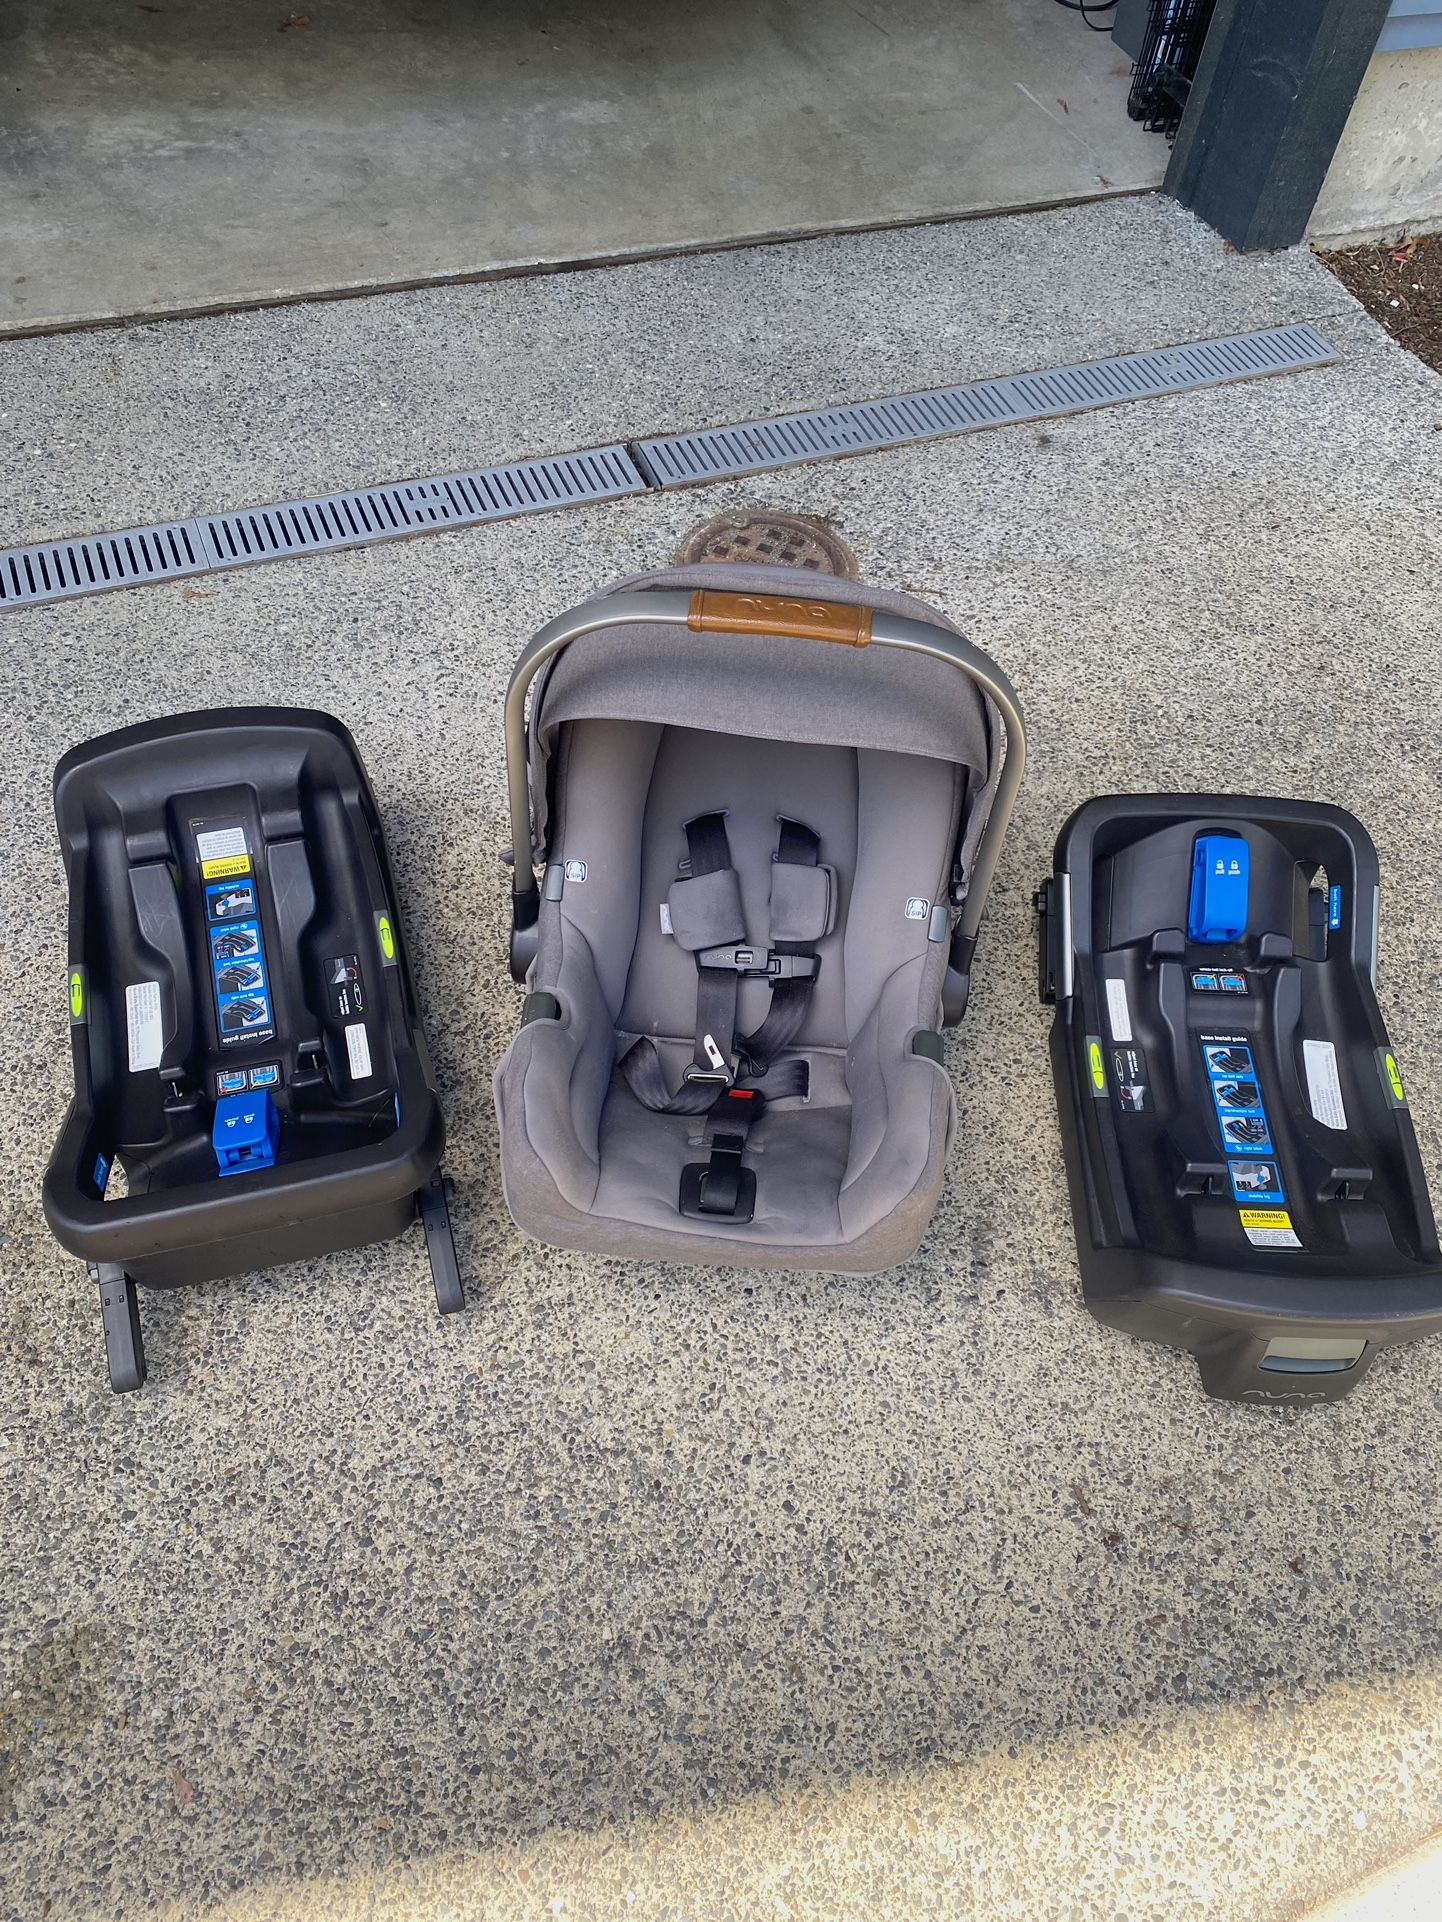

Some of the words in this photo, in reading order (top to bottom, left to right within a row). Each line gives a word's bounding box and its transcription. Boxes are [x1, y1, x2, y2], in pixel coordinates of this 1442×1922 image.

[206, 865, 240, 877] WARNING!
[1249, 1212, 1286, 1220] WARNING!
[1242, 1390, 1326, 1398] nuna
